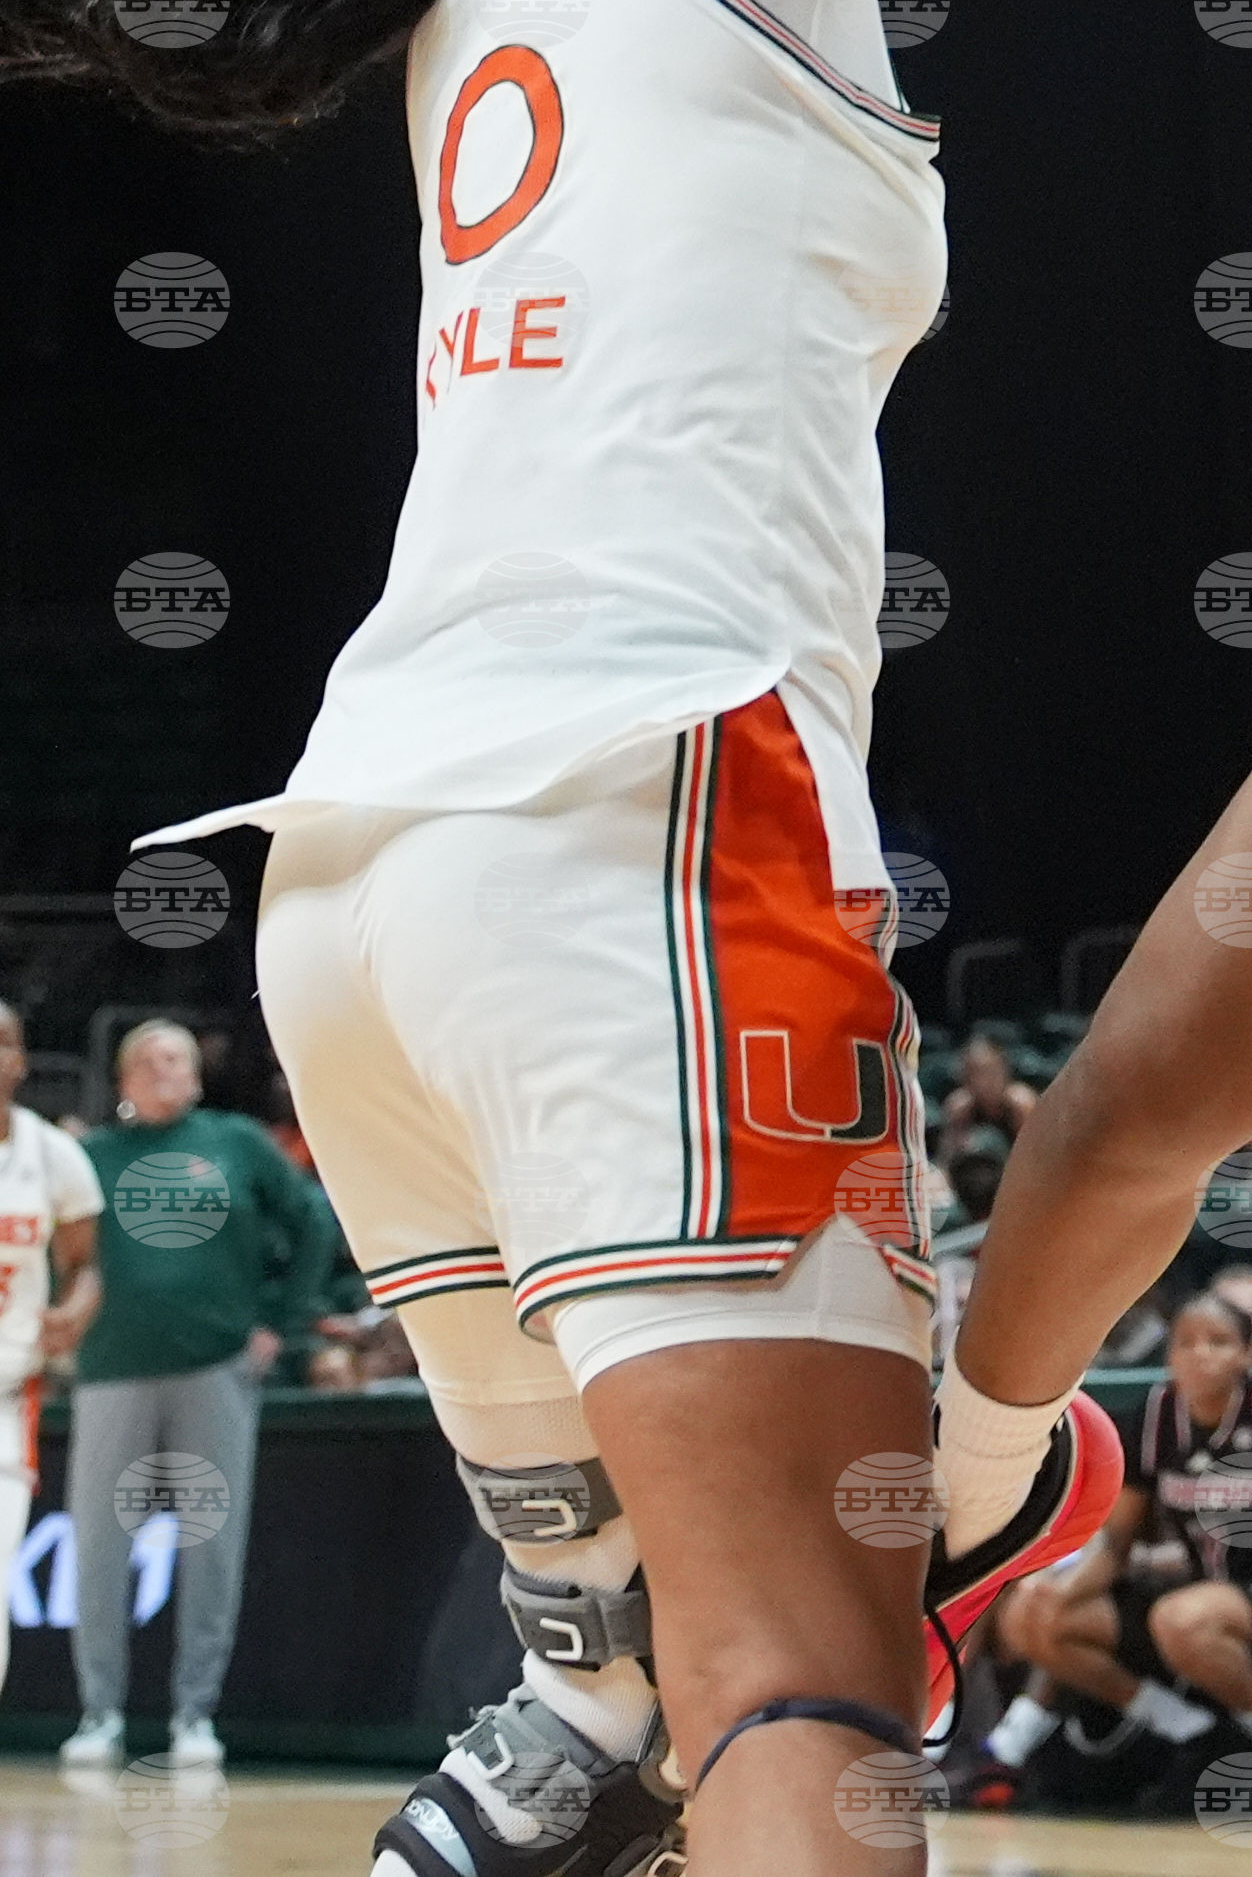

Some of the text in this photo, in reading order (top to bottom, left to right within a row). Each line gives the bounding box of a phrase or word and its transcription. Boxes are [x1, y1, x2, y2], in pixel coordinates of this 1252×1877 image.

[438, 44, 564, 265] 0
[425, 296, 566, 410] YLE
[739, 1029, 890, 1145] U
